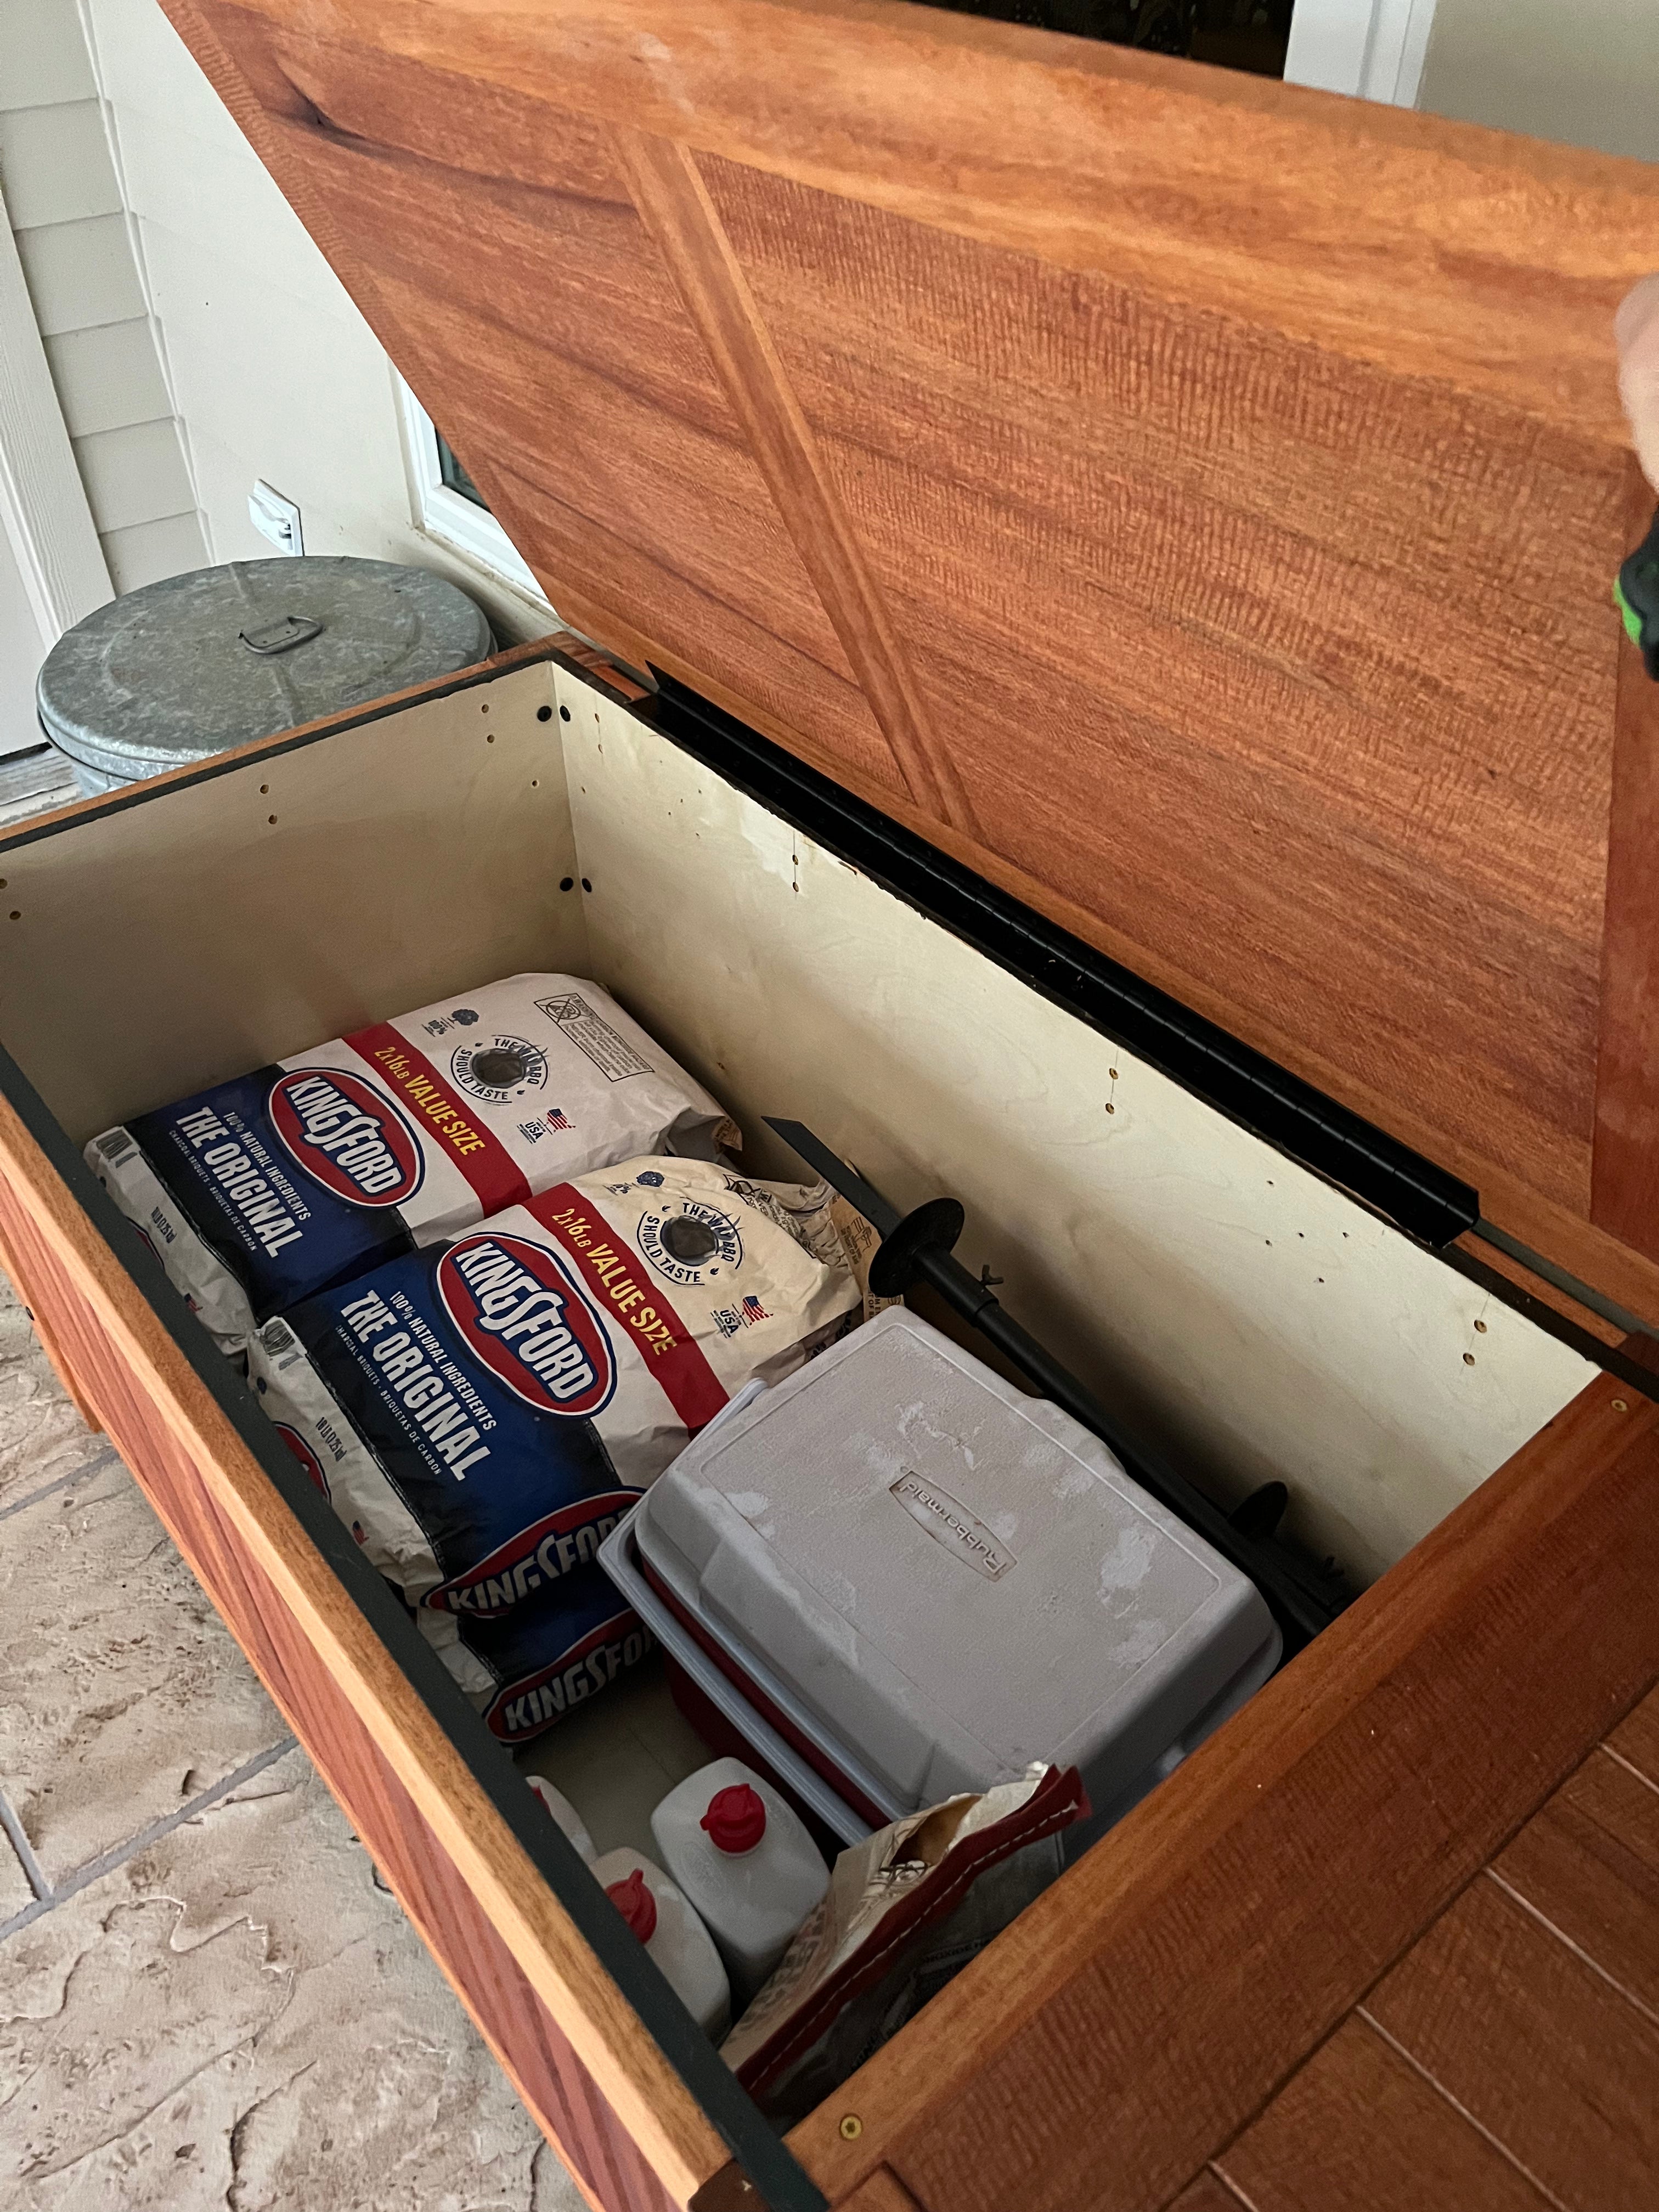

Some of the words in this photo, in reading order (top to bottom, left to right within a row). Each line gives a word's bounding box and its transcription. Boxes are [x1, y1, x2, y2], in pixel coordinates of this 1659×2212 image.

[456, 1049, 472, 1084] SHOULD
[470, 1083, 509, 1100] TASTE
[494, 1038, 518, 1049] THE
[527, 1066, 541, 1085] BBQ
[286, 1076, 402, 1193] KINGSFORD
[405, 1074, 458, 1124] VALUE
[442, 1120, 486, 1156] SIZE
[525, 1121, 544, 1139] USA
[176, 1105, 230, 1148] THE
[204, 1142, 303, 1259] ORIGINAL
[239, 1131, 273, 1169] NATURAL
[266, 1166, 311, 1221] INGREDIENTS
[230, 1216, 240, 1226] DE
[236, 1224, 258, 1251] CARBON
[642, 1216, 662, 1258] SHOULD
[660, 1257, 700, 1283] TASTE
[682, 1203, 708, 1218] THE
[707, 1216, 732, 1239] WAY
[721, 1241, 736, 1262] BBQ
[455, 1242, 594, 1398] KINGSFORD
[586, 1243, 645, 1313] VALUE
[630, 1307, 677, 1356] SIZE
[719, 1310, 741, 1334] USA
[335, 1324, 358, 1357] CHARCOAL
[357, 1355, 380, 1386] BRIQUETS
[380, 1390, 411, 1431] BRIQUETAS
[409, 1431, 419, 1443] DE
[417, 1443, 442, 1475] CARBON
[341, 1289, 398, 1343] THE
[373, 1331, 491, 1481] ORIGINAL
[390, 1291, 416, 1320] 100%
[408, 1317, 447, 1363] NATURAL
[440, 1362, 496, 1430] INGREDIENTS
[899, 1481, 1007, 1574] Rubbermaid
